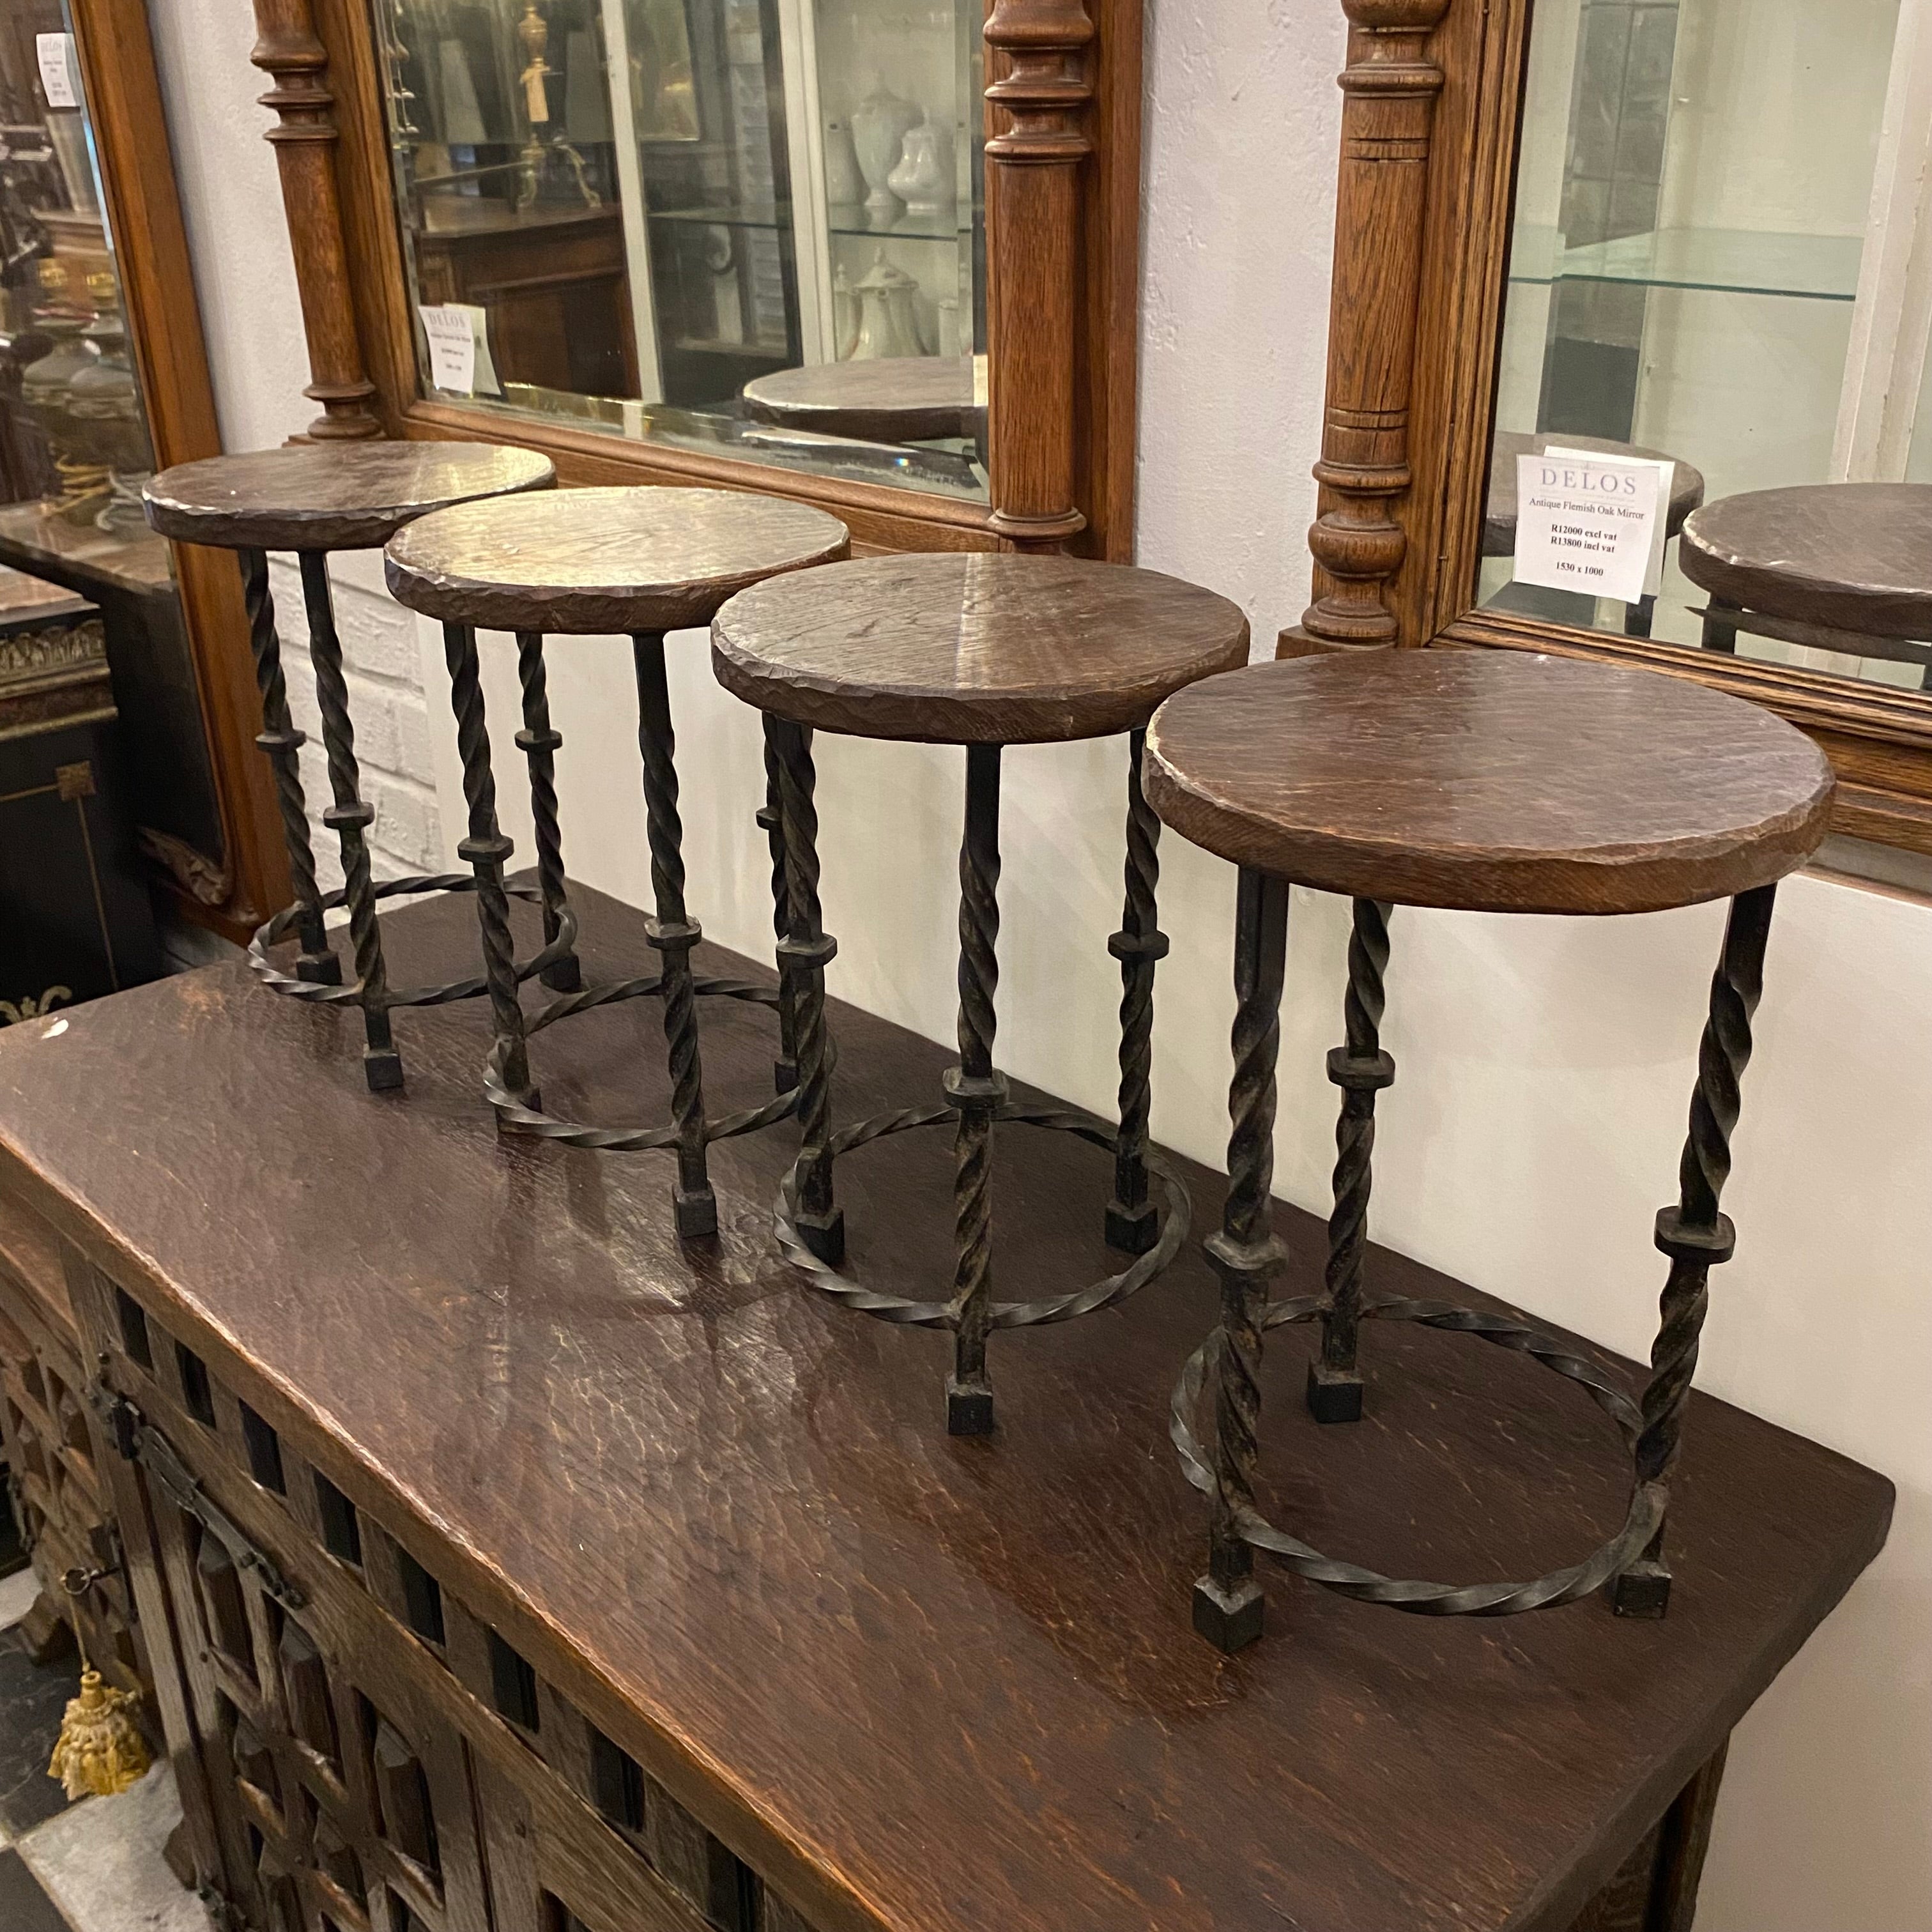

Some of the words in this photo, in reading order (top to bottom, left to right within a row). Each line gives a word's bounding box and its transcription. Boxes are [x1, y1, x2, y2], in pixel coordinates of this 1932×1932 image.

[1542, 468, 1636, 494] DELOS
[1529, 498, 1561, 509] Antique
[1563, 501, 1595, 514] Flemish
[1597, 505, 1614, 516] Oak
[1617, 509, 1645, 520] Mirror
[1551, 524, 1583, 536] R12000
[1584, 529, 1602, 539] excl
[1604, 533, 1617, 541] vat
[1551, 536, 1582, 548] R13800
[1584, 540, 1600, 551] incl
[1602, 545, 1615, 553] vat
[1556, 561, 1575, 572] 1530
[1584, 565, 1604, 577] 1000
